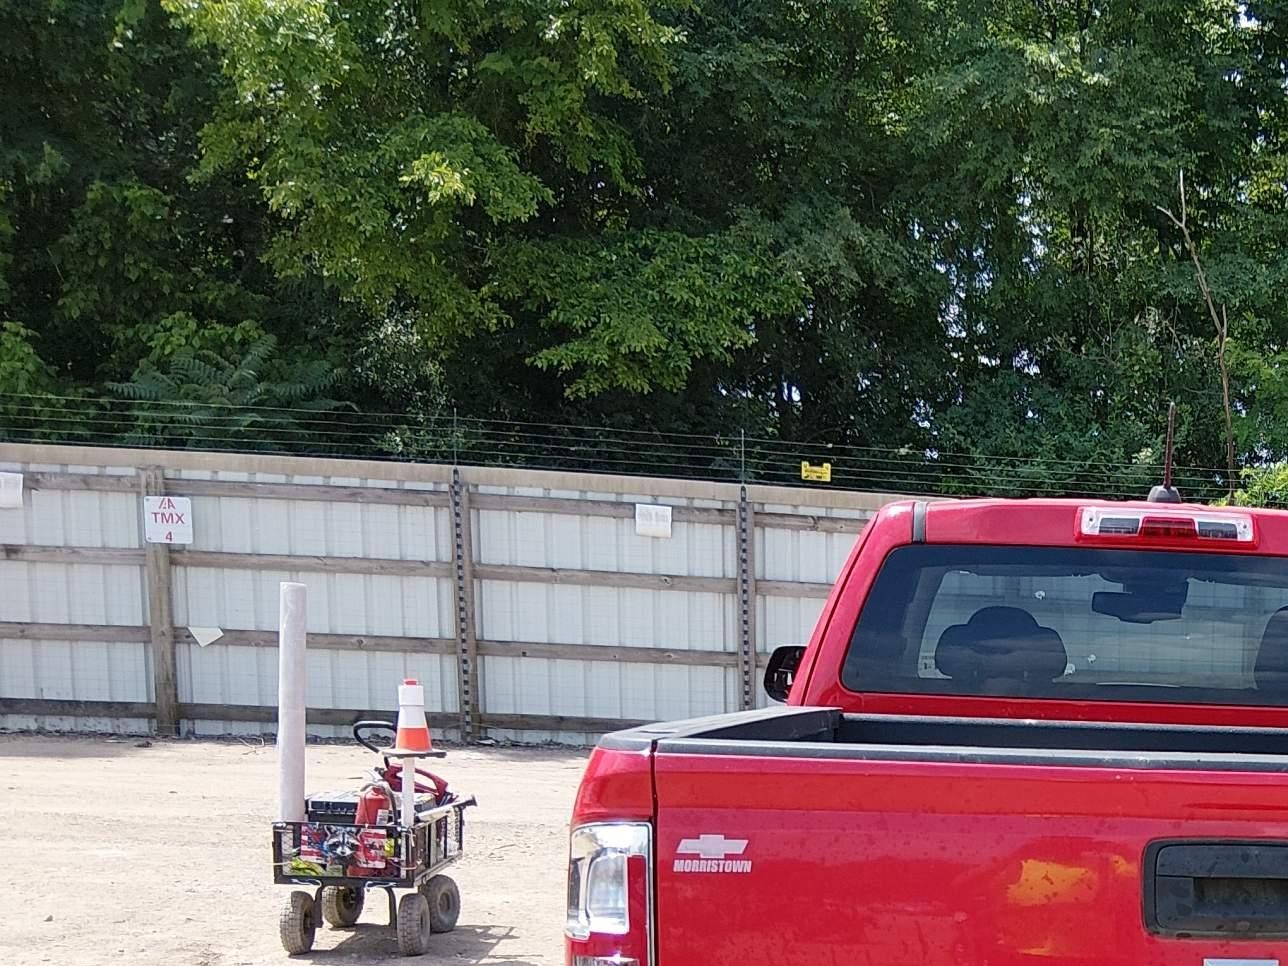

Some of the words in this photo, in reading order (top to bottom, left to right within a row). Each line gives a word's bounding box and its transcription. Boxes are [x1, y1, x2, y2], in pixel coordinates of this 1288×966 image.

[151, 512, 185, 524] TMX
[165, 531, 173, 542] 4
[673, 860, 752, 873] MORRISTOWN
